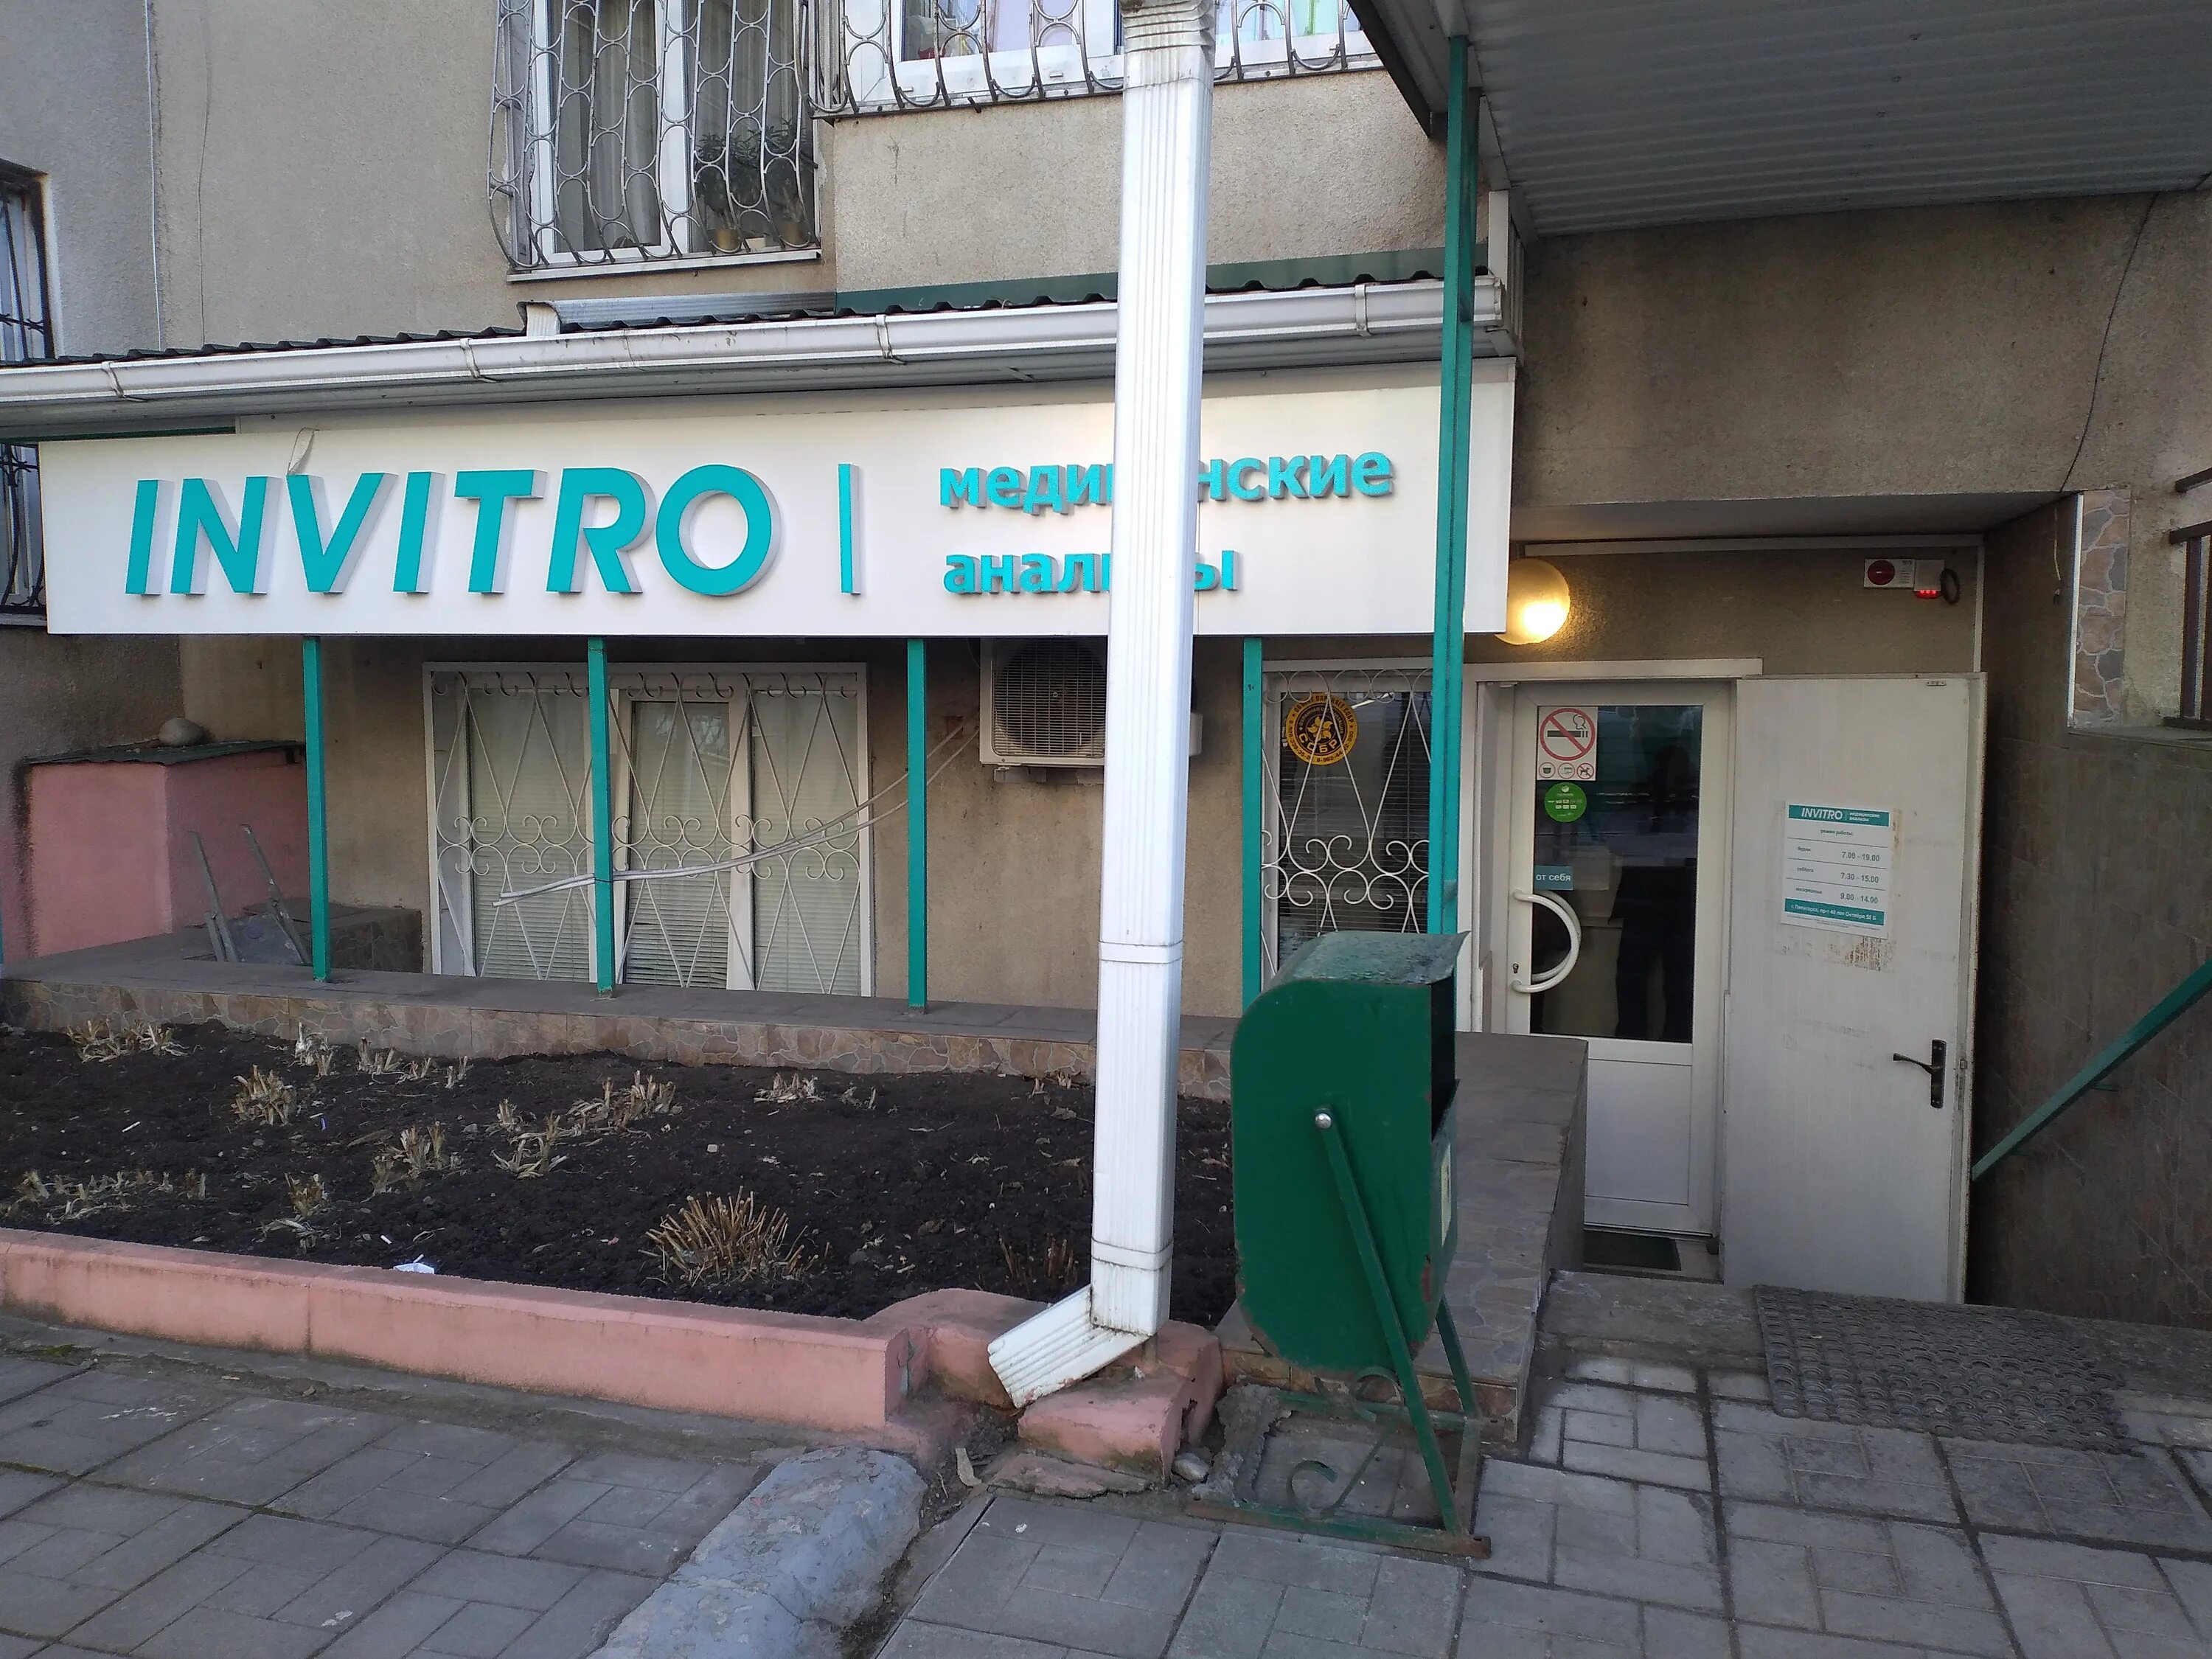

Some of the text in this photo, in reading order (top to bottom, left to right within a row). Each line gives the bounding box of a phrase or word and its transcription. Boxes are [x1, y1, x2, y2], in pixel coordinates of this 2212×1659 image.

[939, 451, 1393, 514] мединские
[125, 464, 777, 596] INVITRO
[943, 549, 1237, 594] аналы
[1801, 807, 1843, 820] INVITRO
[1842, 851, 1856, 859] 7.00
[1862, 853, 1880, 862] 19.00
[1548, 873, 1571, 881] себя
[1861, 874, 1879, 883] 15.00
[1840, 892, 1879, 904] 9.00 14.00
